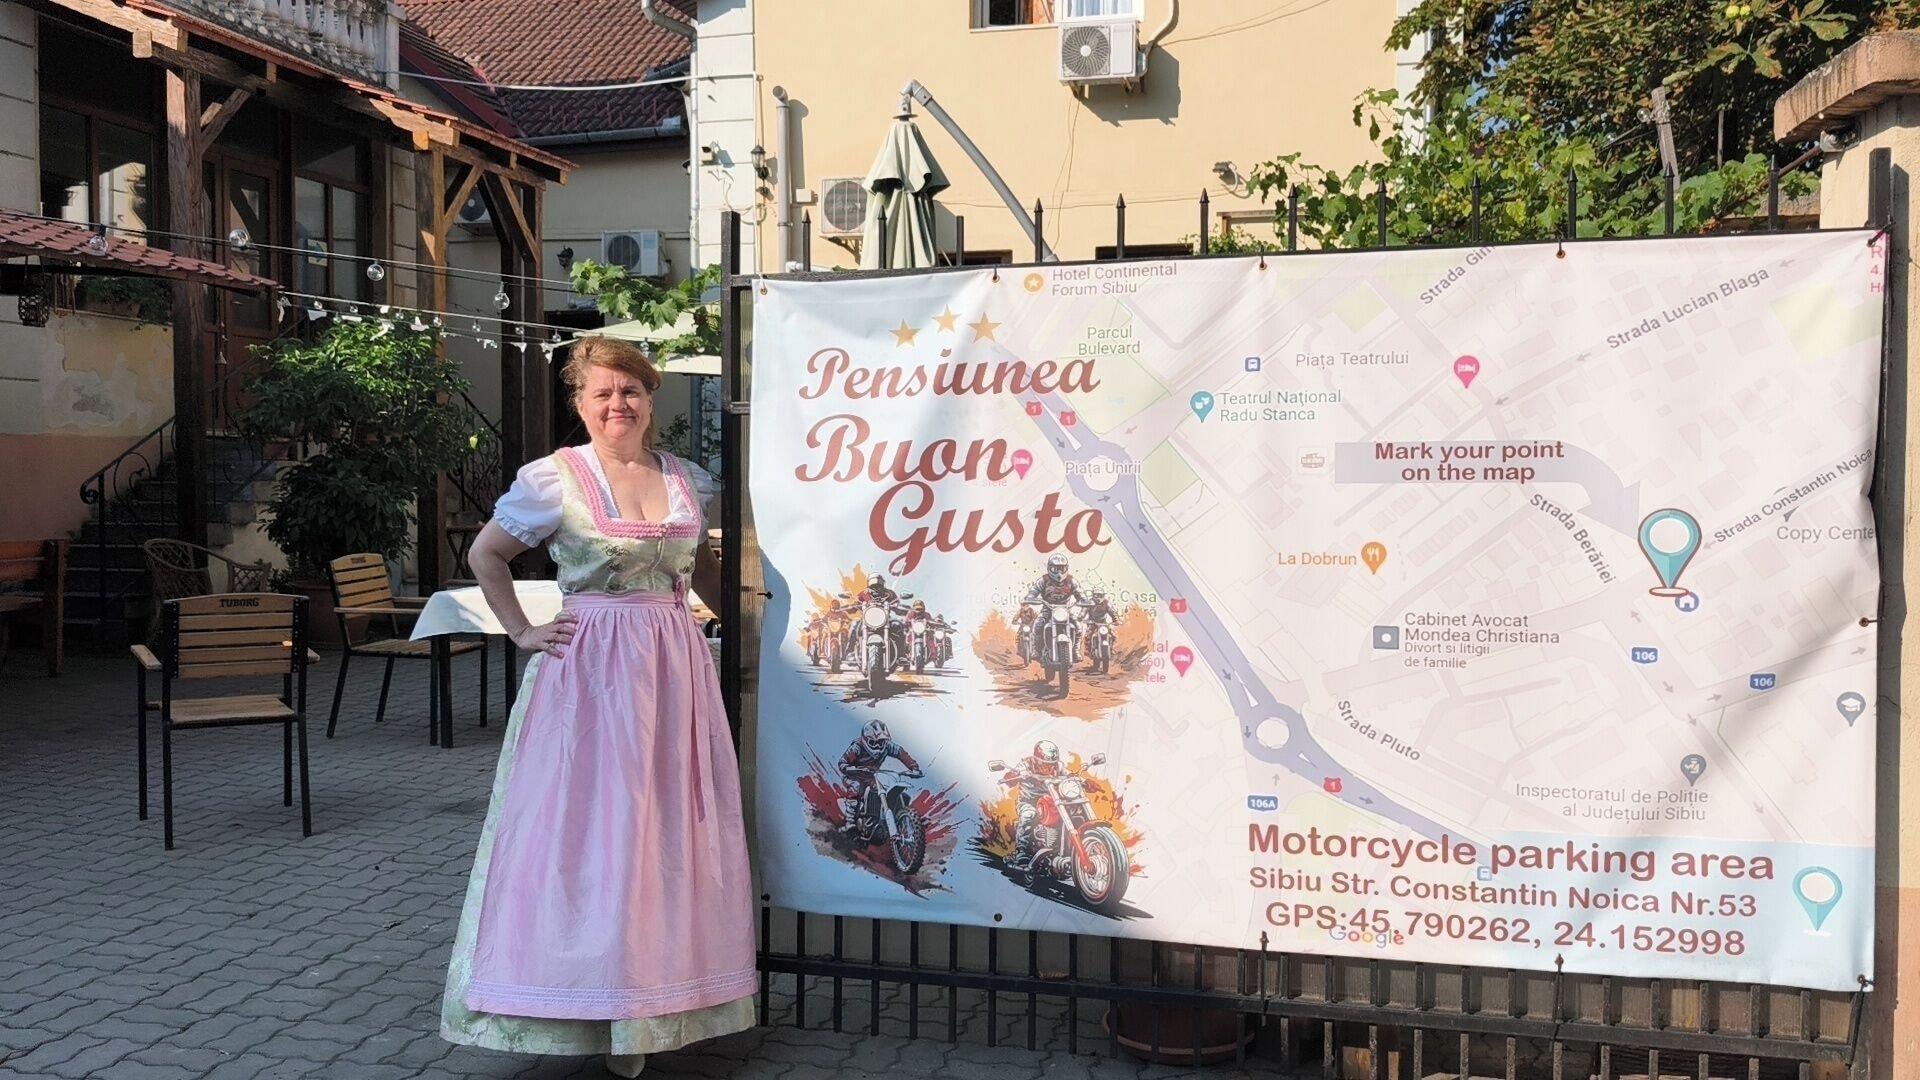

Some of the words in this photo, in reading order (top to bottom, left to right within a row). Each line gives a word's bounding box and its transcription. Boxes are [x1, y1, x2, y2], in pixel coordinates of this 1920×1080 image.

[1053, 266, 1090, 281] Hotel
[1095, 262, 1177, 280] Continental
[1052, 284, 1098, 297] Forum
[1102, 280, 1137, 294] Sibiu
[1419, 266, 1466, 305] Strada
[1606, 317, 1661, 350] Strada
[1662, 291, 1720, 325] Lucian
[1719, 267, 1770, 300] Blaga
[1087, 325, 1133, 339] Parcul
[1078, 340, 1141, 356] Bulevard
[1340, 350, 1409, 366] Teatrului
[798, 347, 1101, 400] Pensiunea
[1220, 390, 1273, 405] Teatrul
[1220, 408, 1257, 422] Radu
[1262, 407, 1316, 422] Stanca
[794, 414, 1015, 485] Buon
[1374, 442, 1434, 460] Mark
[1439, 445, 1495, 463] your
[1501, 441, 1565, 463] point
[1105, 460, 1141, 475] Unirii
[1401, 467, 1430, 482] on
[1438, 464, 1477, 482] the
[1482, 466, 1536, 484] map
[1714, 511, 1762, 544] Strada
[1761, 470, 1837, 517] Constantin
[1835, 448, 1873, 475] Noica
[868, 480, 1113, 577] Gusto
[1776, 525, 1823, 544] Copy
[1828, 525, 1876, 541] Cente
[1529, 493, 1576, 531] Strada
[1573, 527, 1618, 584] Berăriei
[1278, 552, 1297, 565] La
[1301, 551, 1358, 566] Dobrun
[219, 597, 260, 608] TUBORG
[1404, 612, 1467, 627] Cabinet
[1472, 613, 1529, 628] Avocat
[1404, 628, 1471, 642] Mondea
[1475, 629, 1560, 644] Christiana
[1404, 642, 1442, 654] Divort
[1446, 644, 1456, 654] si
[1460, 643, 1490, 657] litigii
[1633, 650, 1656, 662] 106
[1404, 656, 1420, 668] de
[1424, 656, 1467, 669] familie
[1752, 677, 1774, 688] 106
[1337, 699, 1377, 741] Strada
[1379, 733, 1421, 762] Pluto
[1515, 783, 1626, 803] Inspectoratul
[1631, 788, 1651, 803] de
[1250, 798, 1275, 808] 106A
[1562, 804, 1577, 817] al
[1665, 806, 1706, 821] Sibiu
[1249, 823, 1477, 868] Motorcycle
[1491, 840, 1656, 881] parking
[1671, 851, 1775, 880] area
[1250, 867, 1321, 892] Sibiu
[1331, 871, 1379, 896] Str.
[1390, 875, 1557, 907] Constantin
[1568, 887, 1660, 914] Noica
[1671, 891, 1757, 917] Nr.53
[1328, 923, 1405, 950] Google
[1553, 921, 1746, 957] 24.152998
